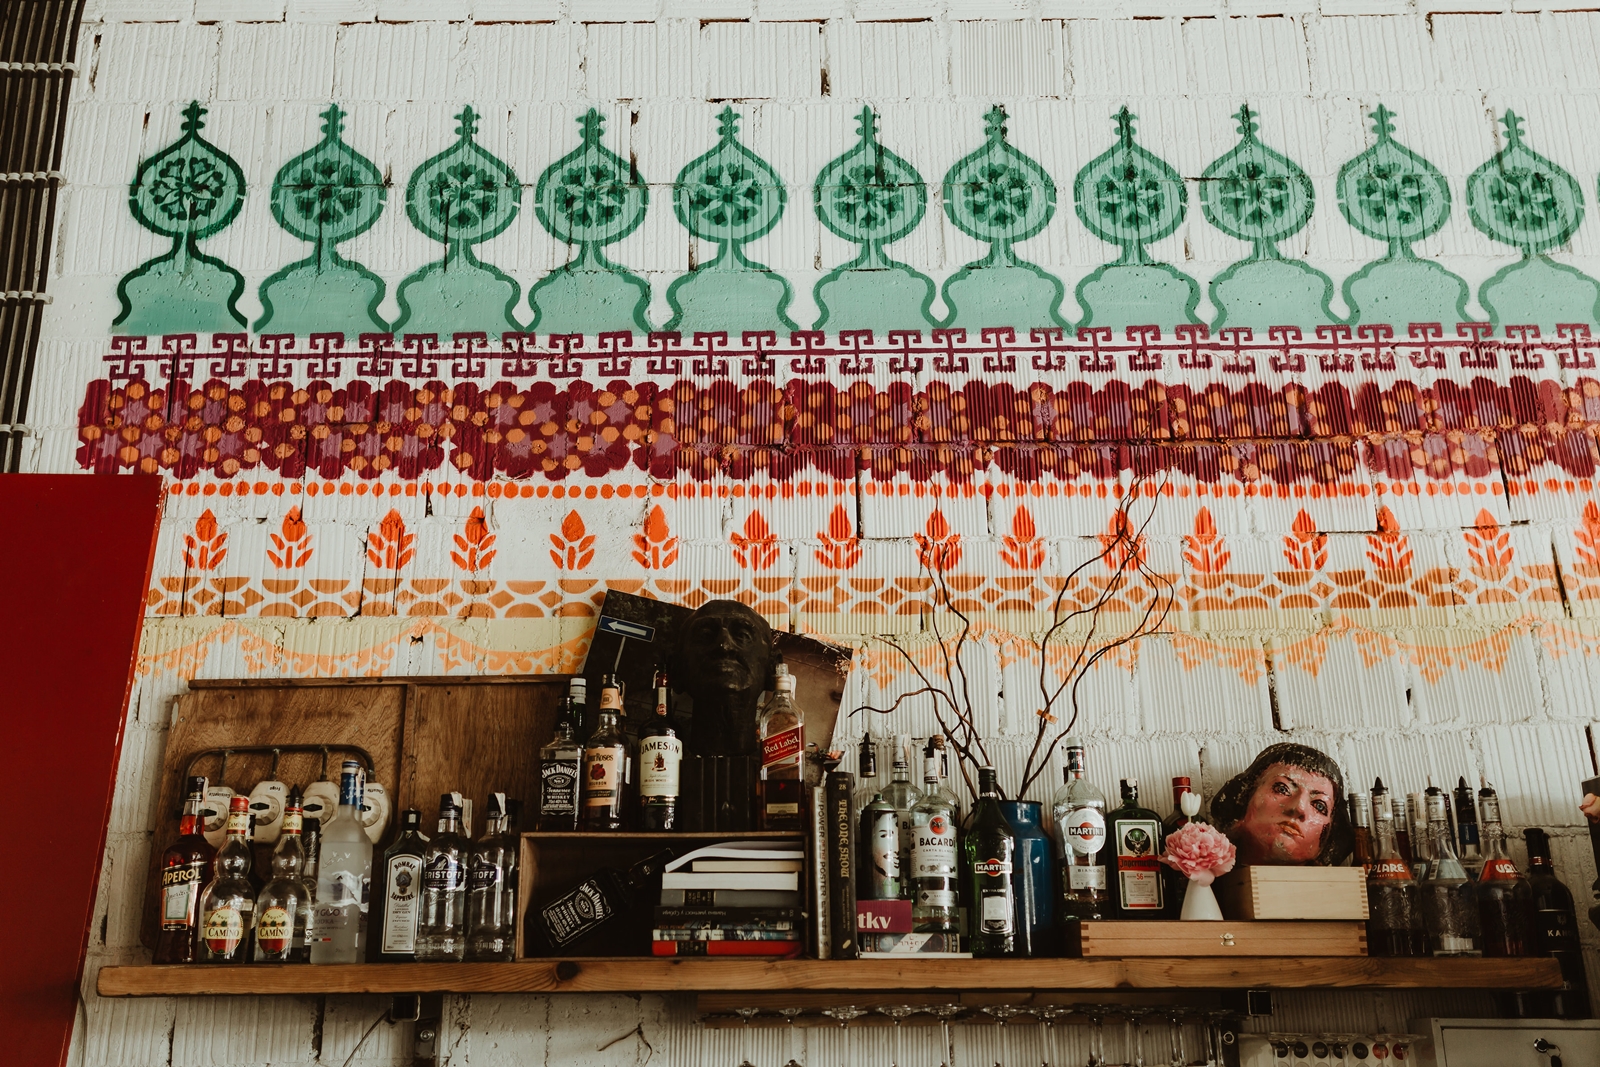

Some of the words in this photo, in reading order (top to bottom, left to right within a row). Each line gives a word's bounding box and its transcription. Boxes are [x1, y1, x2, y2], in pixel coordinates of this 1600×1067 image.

[641, 741, 680, 755] JAMESON
[764, 743, 779, 754] Red
[595, 752, 614, 761] Roses
[541, 766, 556, 779] JACK
[393, 861, 416, 872] BOMBAY
[162, 868, 201, 886] APEROL
[425, 870, 462, 880] ERISTOFF
[390, 891, 416, 901] SAPPHIRE
[579, 882, 595, 898] JACK
[560, 905, 575, 928] WHISKEY
[857, 912, 891, 929] tkv
[208, 927, 240, 938] CAMINO
[260, 926, 290, 938] CAMINO
